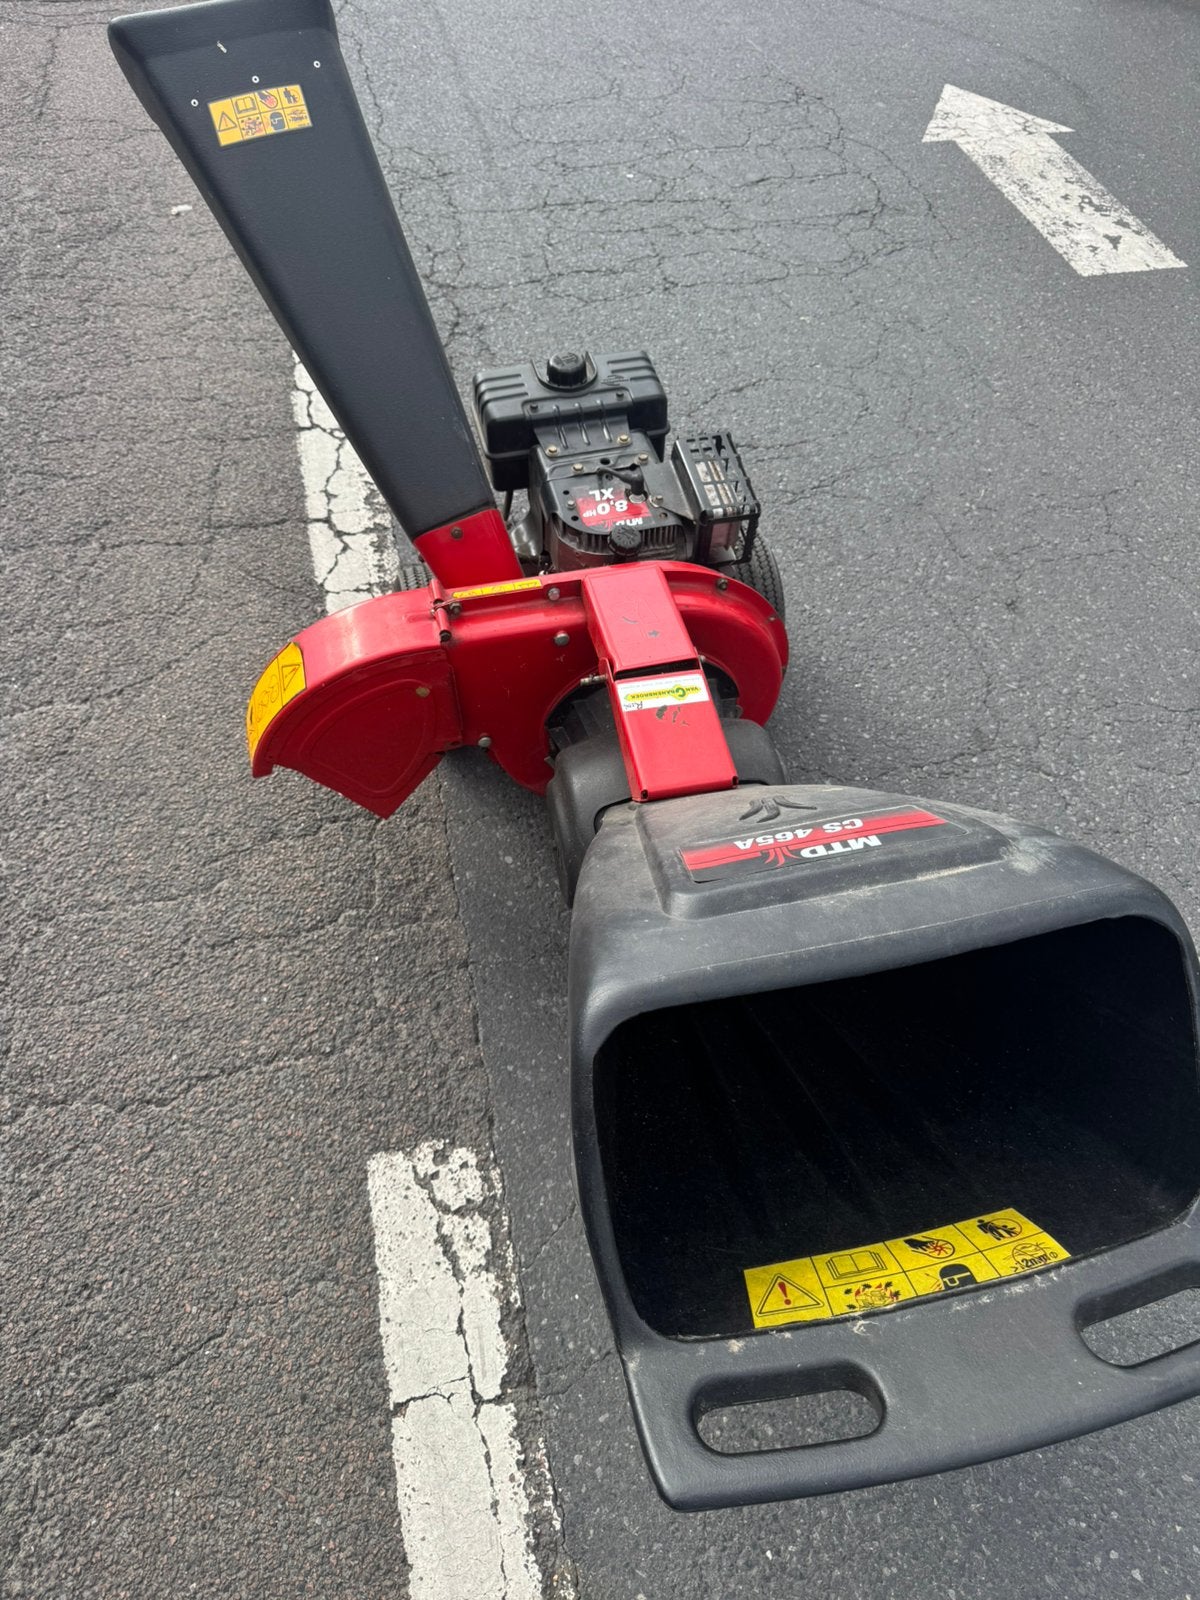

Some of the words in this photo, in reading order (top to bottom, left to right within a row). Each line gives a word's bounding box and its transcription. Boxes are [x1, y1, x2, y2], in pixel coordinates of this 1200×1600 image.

[588, 488, 614, 500] XL
[822, 818, 864, 833] CS
[734, 828, 813, 850] 465A
[800, 834, 882, 859] MTD
